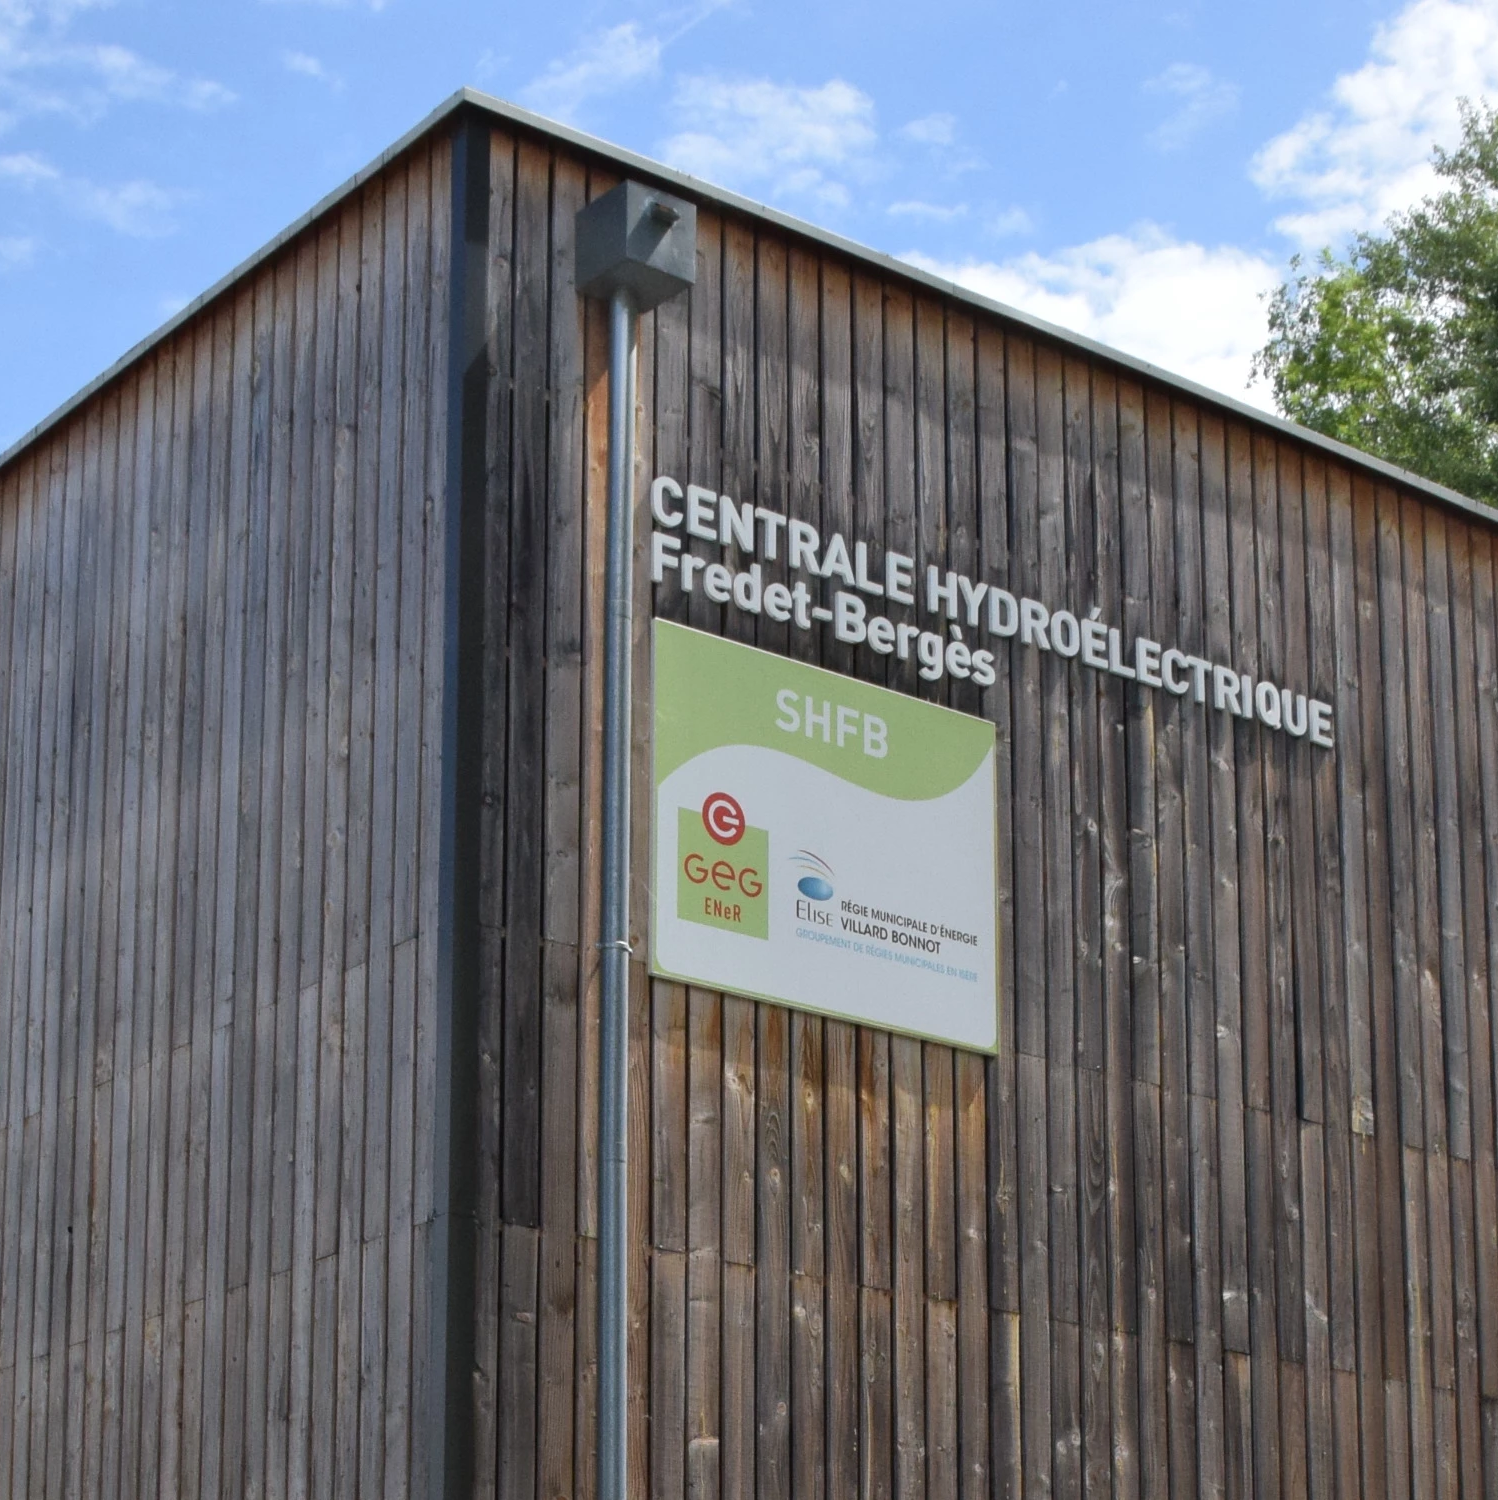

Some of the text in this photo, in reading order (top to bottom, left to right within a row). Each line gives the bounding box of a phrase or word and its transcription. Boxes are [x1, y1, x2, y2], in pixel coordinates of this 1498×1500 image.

[651, 531, 996, 687] Fredet-Bergès
[651, 475, 1334, 749] CENTRALE HYDROÉLECTRIQUE
[775, 688, 889, 759] SHFB
[840, 916, 941, 954] VILLARD BONNOT
[841, 899, 978, 946] RÉGIE MUNICIPALE D'ÉNERGIE
